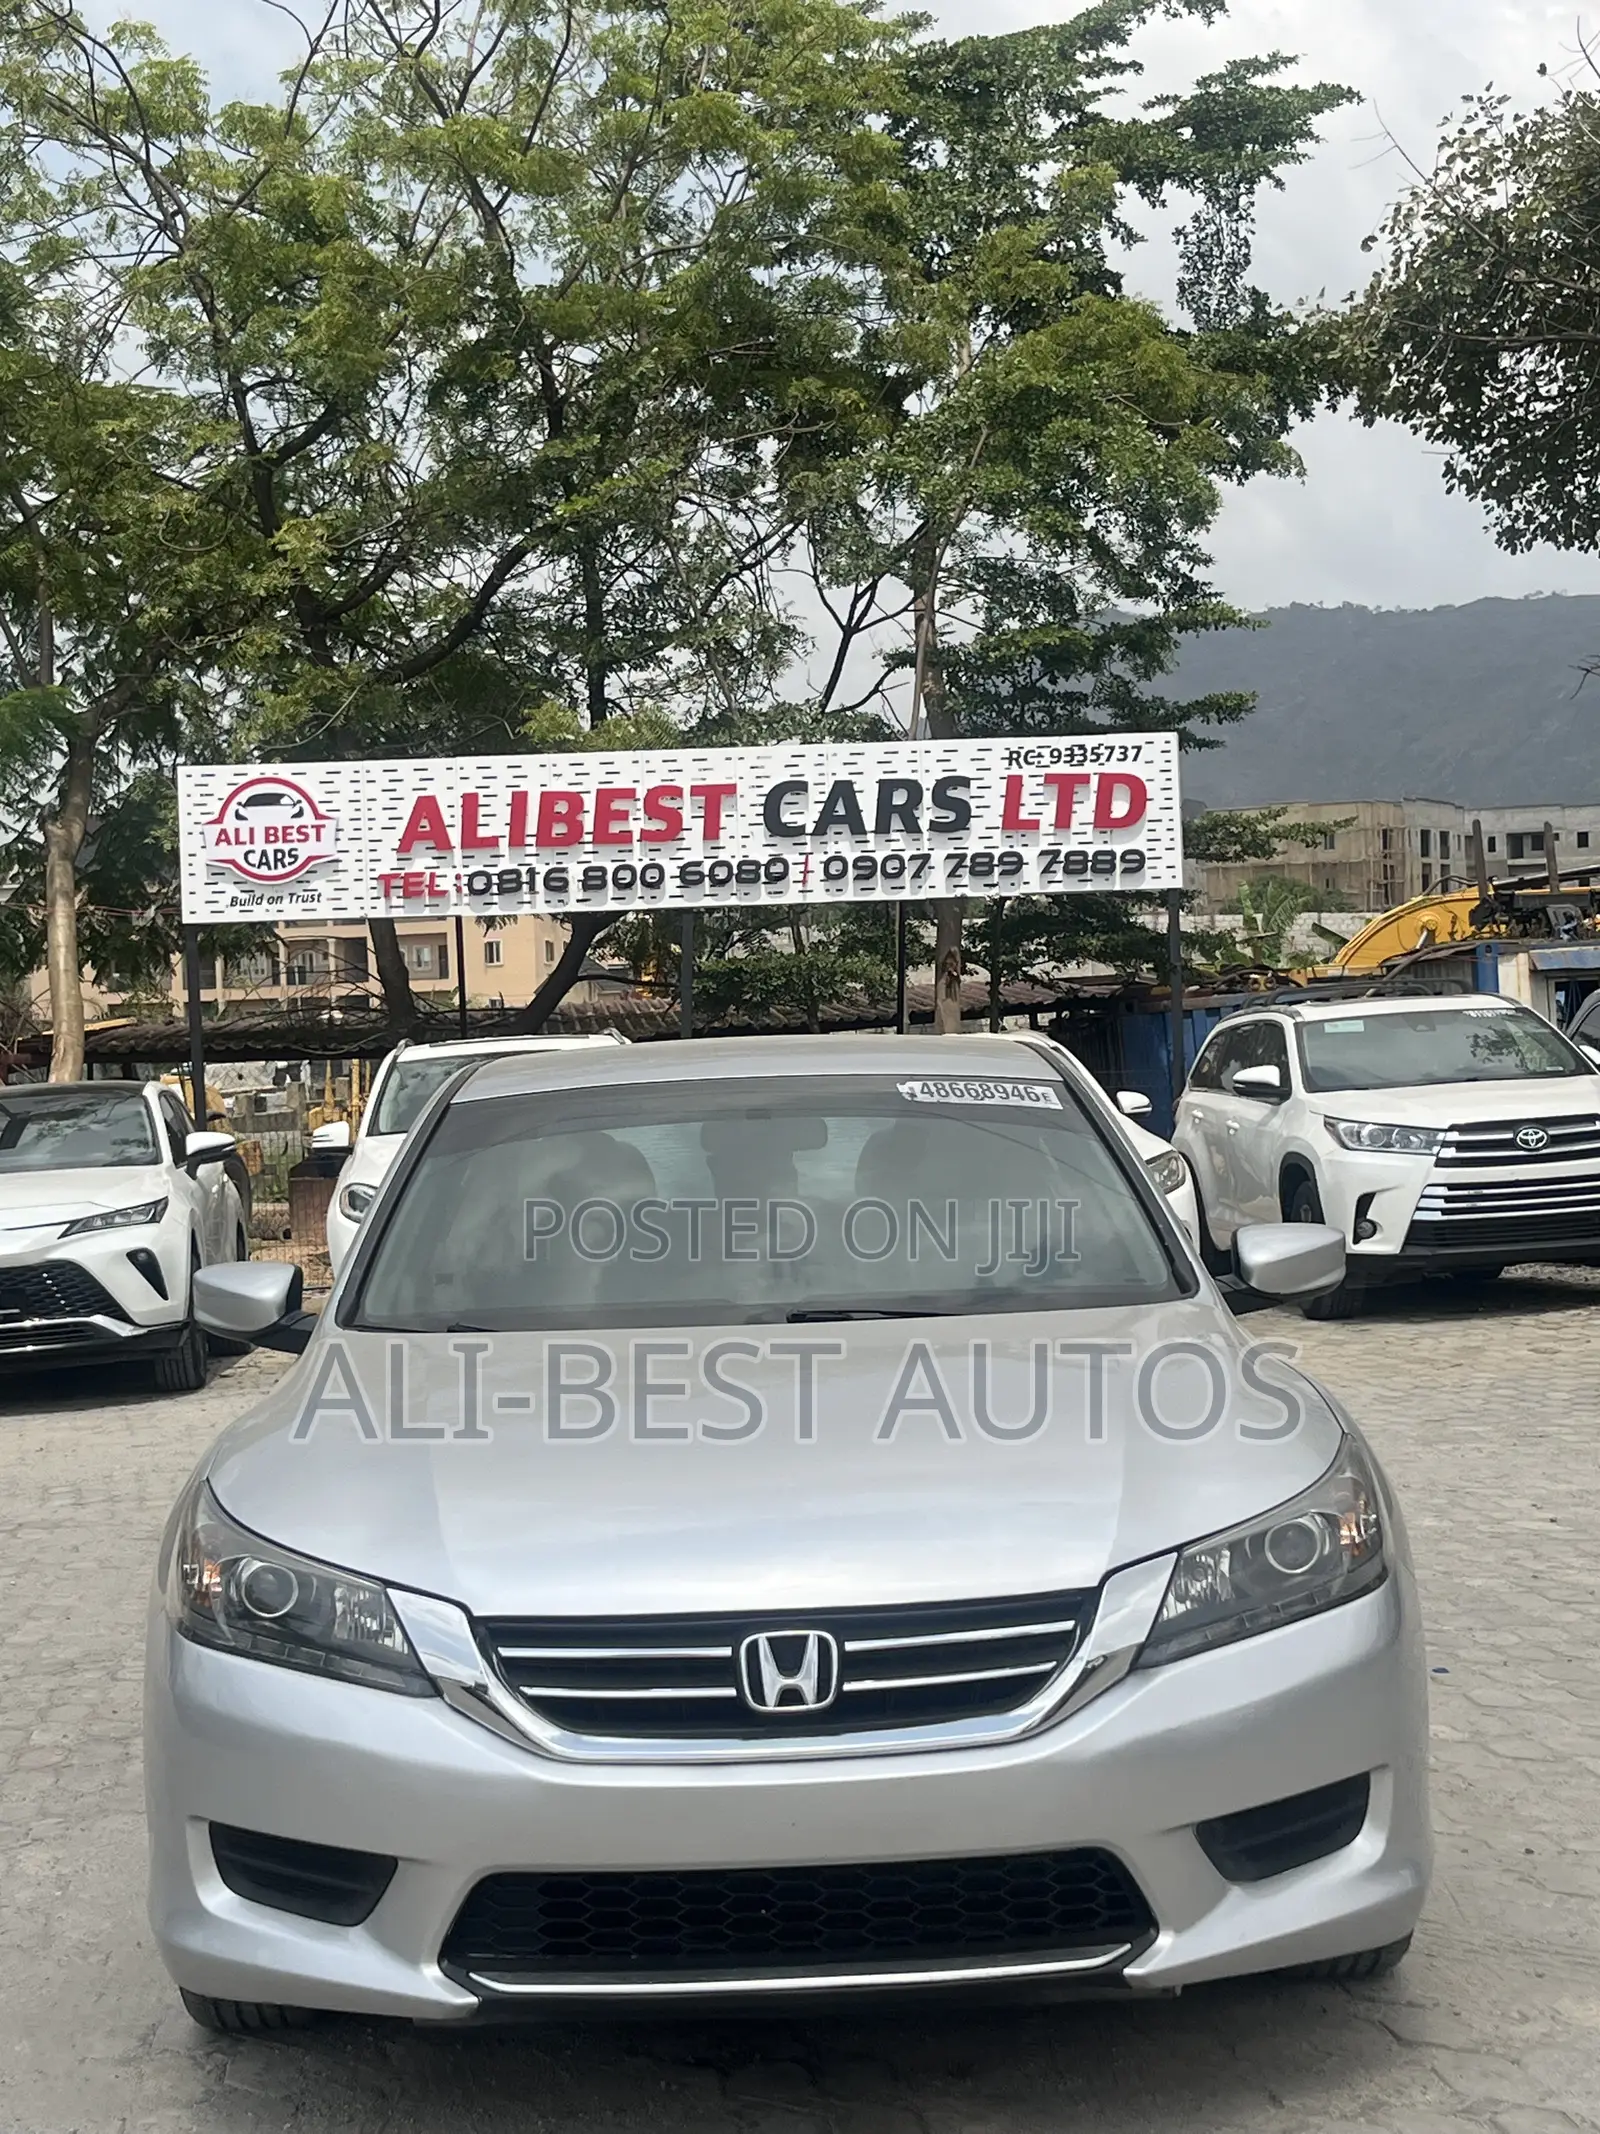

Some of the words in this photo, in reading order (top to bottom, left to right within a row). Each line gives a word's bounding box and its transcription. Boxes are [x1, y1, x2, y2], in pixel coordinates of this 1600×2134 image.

[1049, 745, 1142, 764] 9335737
[397, 783, 737, 853] ALIBEST
[763, 775, 972, 837] CARS
[1001, 772, 1148, 831] LTD
[215, 827, 255, 846] ALI
[264, 824, 326, 844] BEST
[243, 848, 299, 871] CARS
[468, 867, 569, 895] 0816
[582, 863, 666, 892] 800
[680, 857, 789, 885] 6080
[824, 853, 932, 881] 0907
[944, 851, 1024, 879] 789
[1038, 848, 1146, 876] 7889
[230, 894, 265, 907] Build
[266, 896, 284, 905] on
[288, 891, 323, 904] Trust
